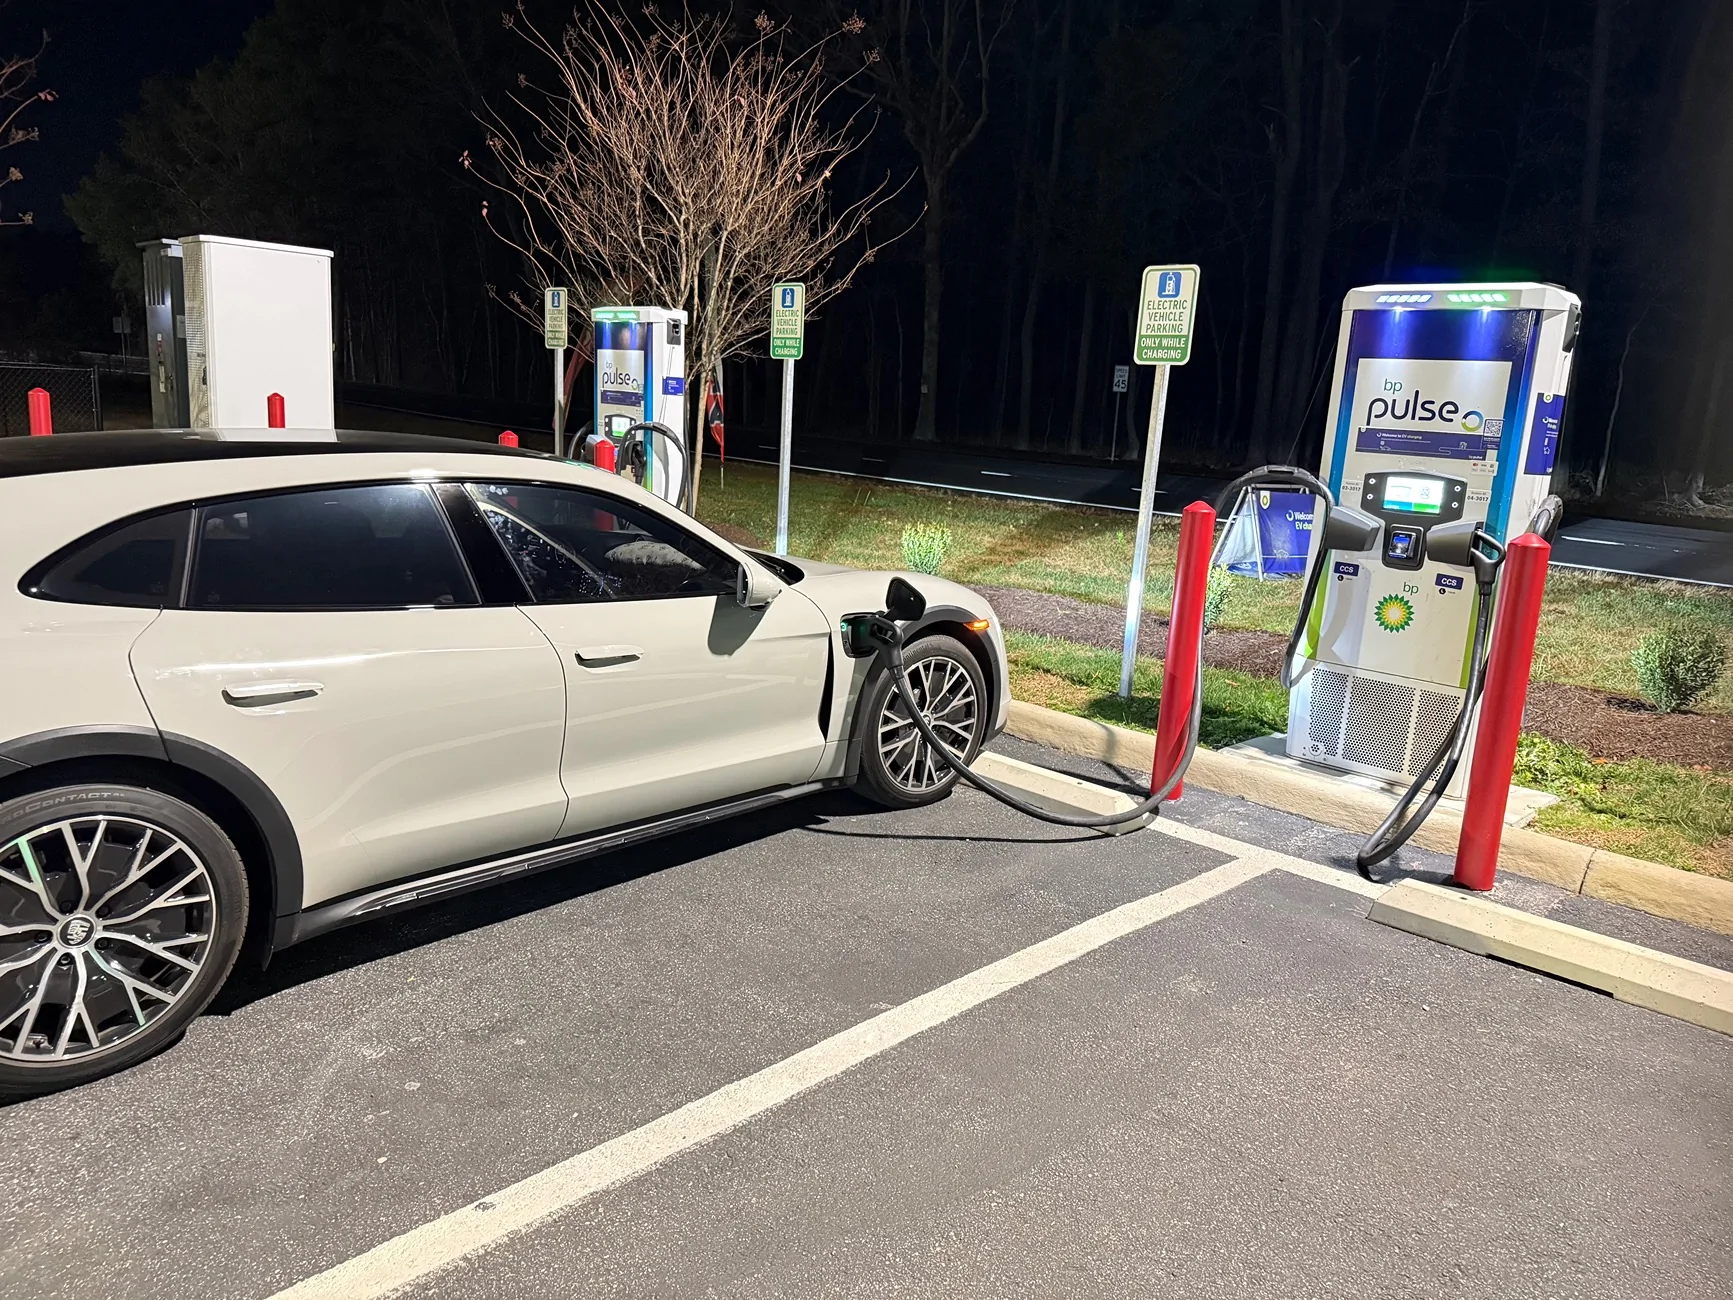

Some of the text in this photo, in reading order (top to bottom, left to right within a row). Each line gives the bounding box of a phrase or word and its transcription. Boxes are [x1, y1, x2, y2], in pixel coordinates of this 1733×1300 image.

[1147, 299, 1188, 310] ELECTRIC
[1148, 311, 1184, 322] VEHICLE
[777, 318, 797, 326] VEHICLE
[1146, 323, 1183, 333] PARKING
[1140, 337, 1186, 347] ONLY WHILE
[775, 347, 797, 355] CHARGING
[1142, 349, 1181, 359] CHARGING
[602, 367, 631, 388] pulse
[1114, 379, 1127, 390] 45
[1383, 378, 1403, 394] bp
[1366, 389, 1459, 426] pulse
[1294, 511, 1314, 521] Welcom
[1295, 521, 1312, 530] EV cha
[1339, 565, 1354, 573] CCS
[1441, 577, 1457, 587] CCS
[1403, 581, 1419, 596] bp
[903, 643, 929, 661] ontinental
